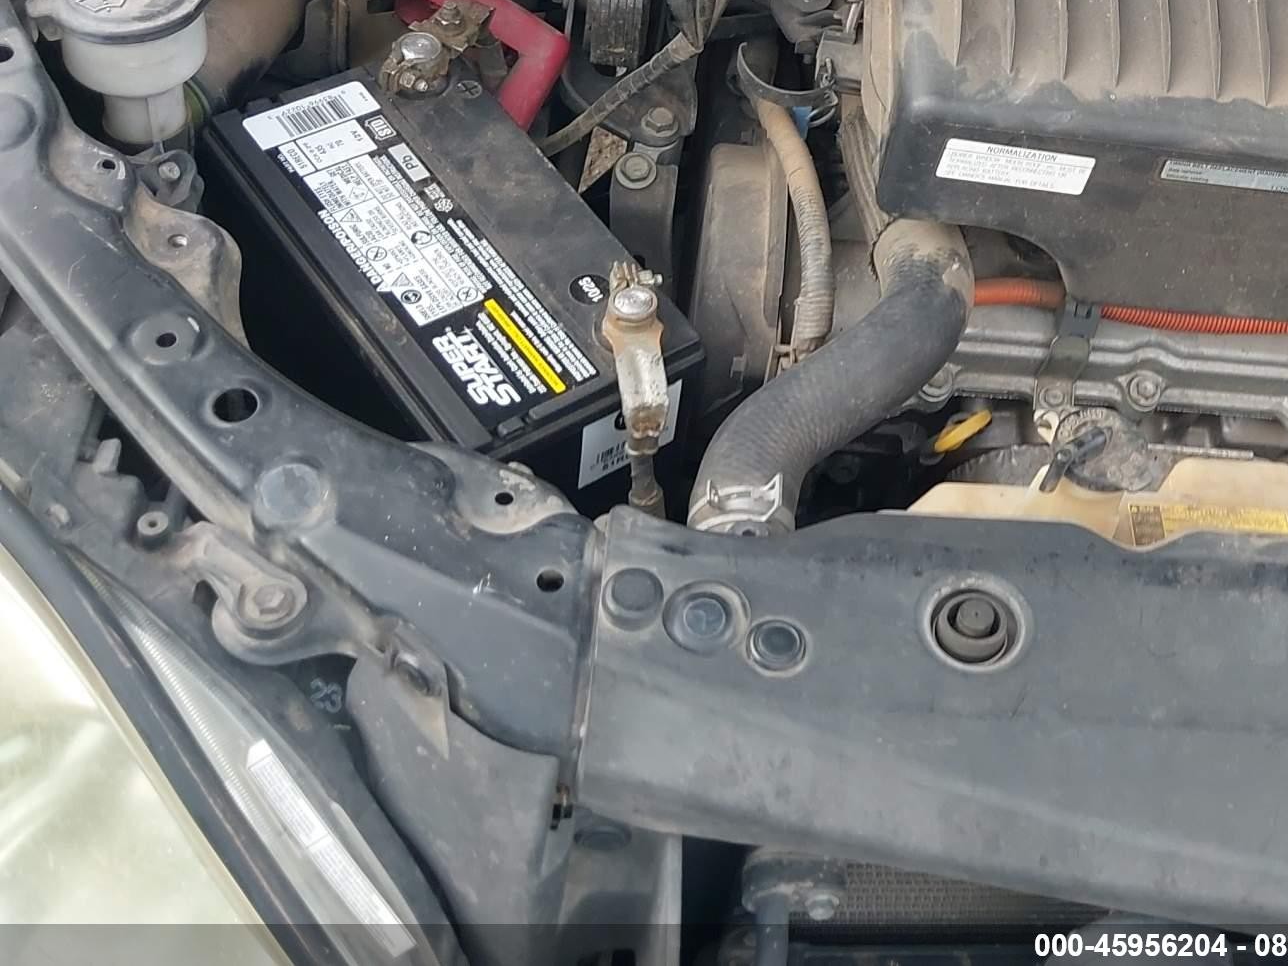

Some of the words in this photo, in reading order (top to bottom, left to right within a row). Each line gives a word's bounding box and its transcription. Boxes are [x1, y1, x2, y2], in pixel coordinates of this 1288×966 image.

[348, 128, 365, 142] 12V
[368, 117, 393, 137] STD
[285, 147, 308, 169] 51RECO
[397, 153, 420, 171] Pb
[985, 144, 1059, 162] NORMALIZATION
[281, 160, 296, 173] PART
[315, 207, 383, 285] DANGER/POISON
[577, 274, 604, 304] 10/25
[431, 333, 491, 406] SUPER
[445, 327, 522, 407] START
